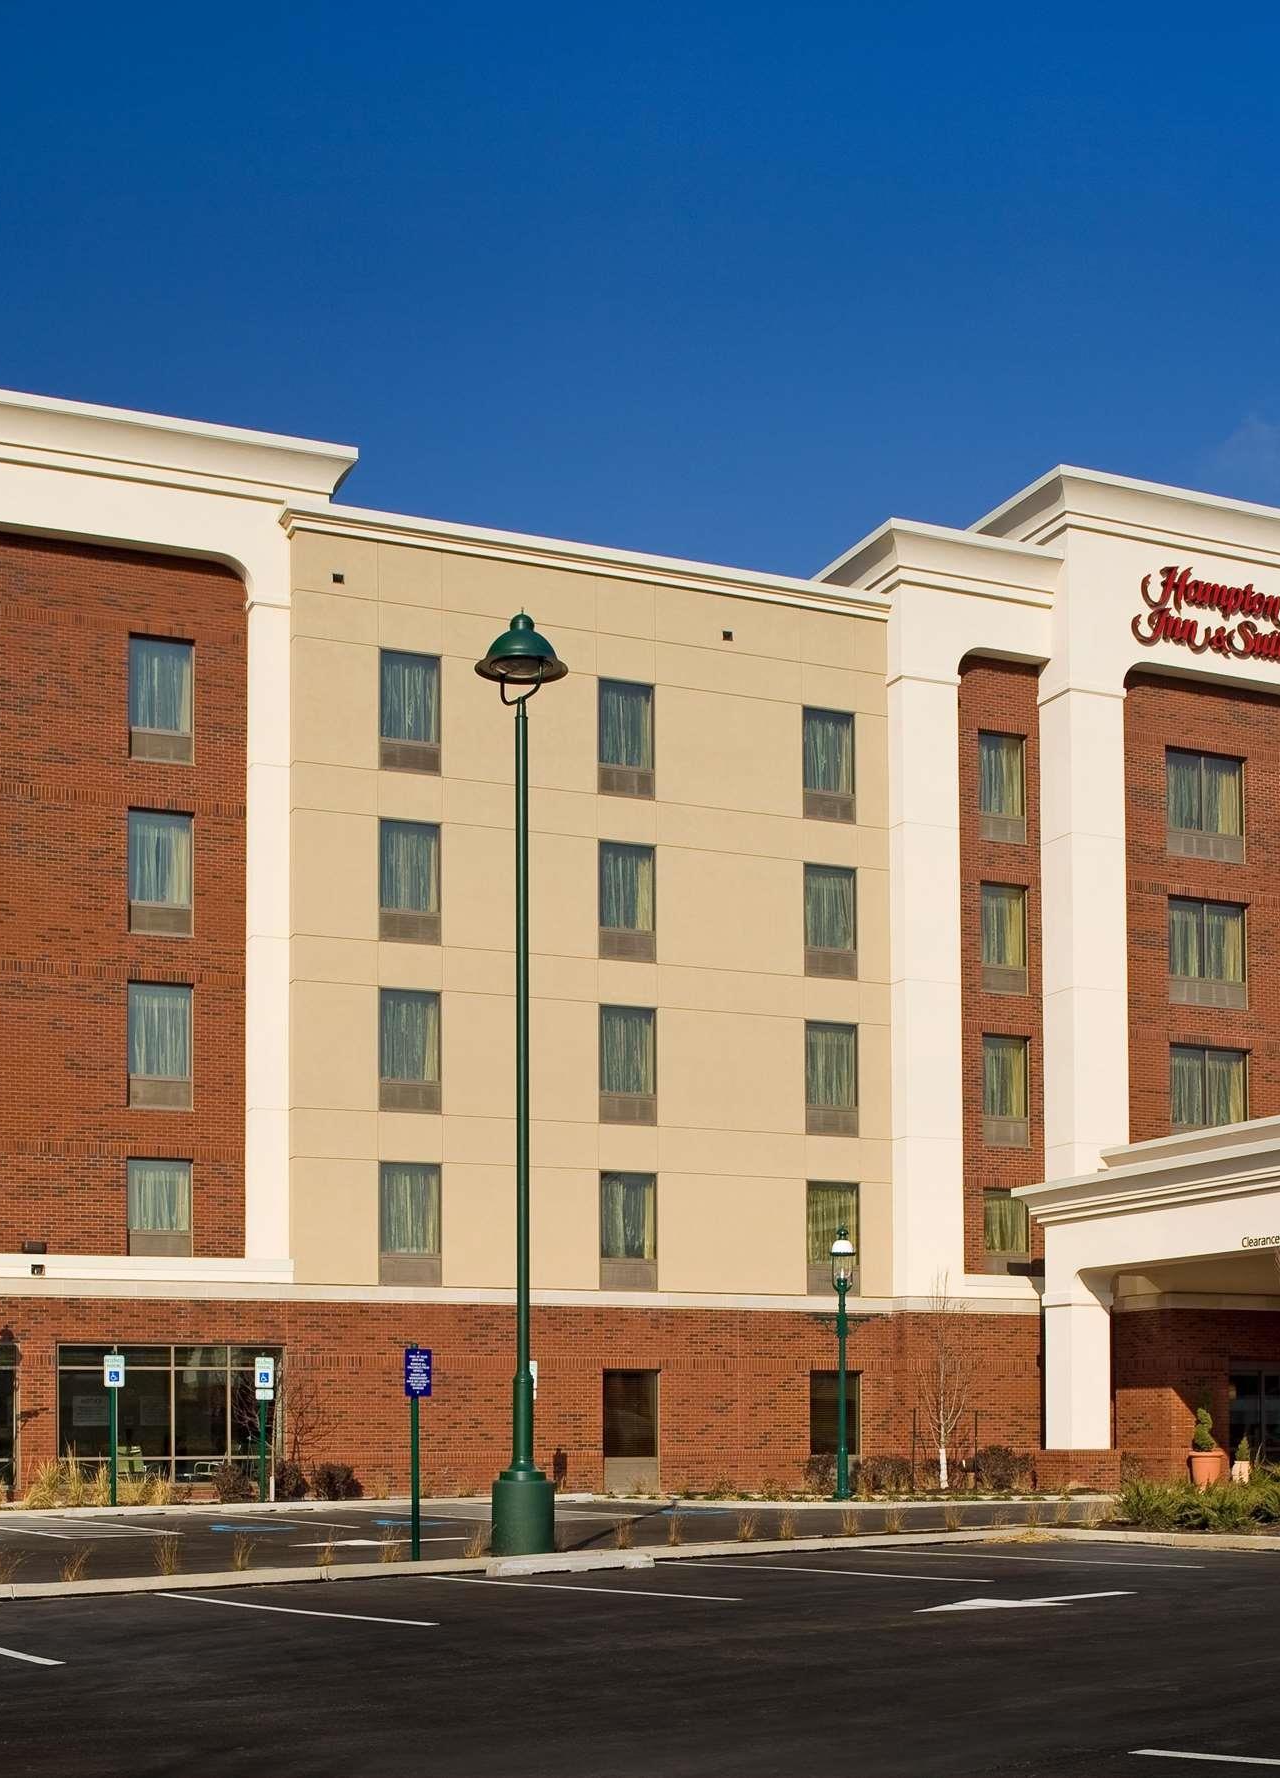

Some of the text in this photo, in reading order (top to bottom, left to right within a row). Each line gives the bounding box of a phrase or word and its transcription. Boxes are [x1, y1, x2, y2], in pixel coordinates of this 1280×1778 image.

[1131, 608, 1211, 654] Inn
[1209, 626, 1231, 659] &
[1241, 1235, 1280, 1248] Clearance
